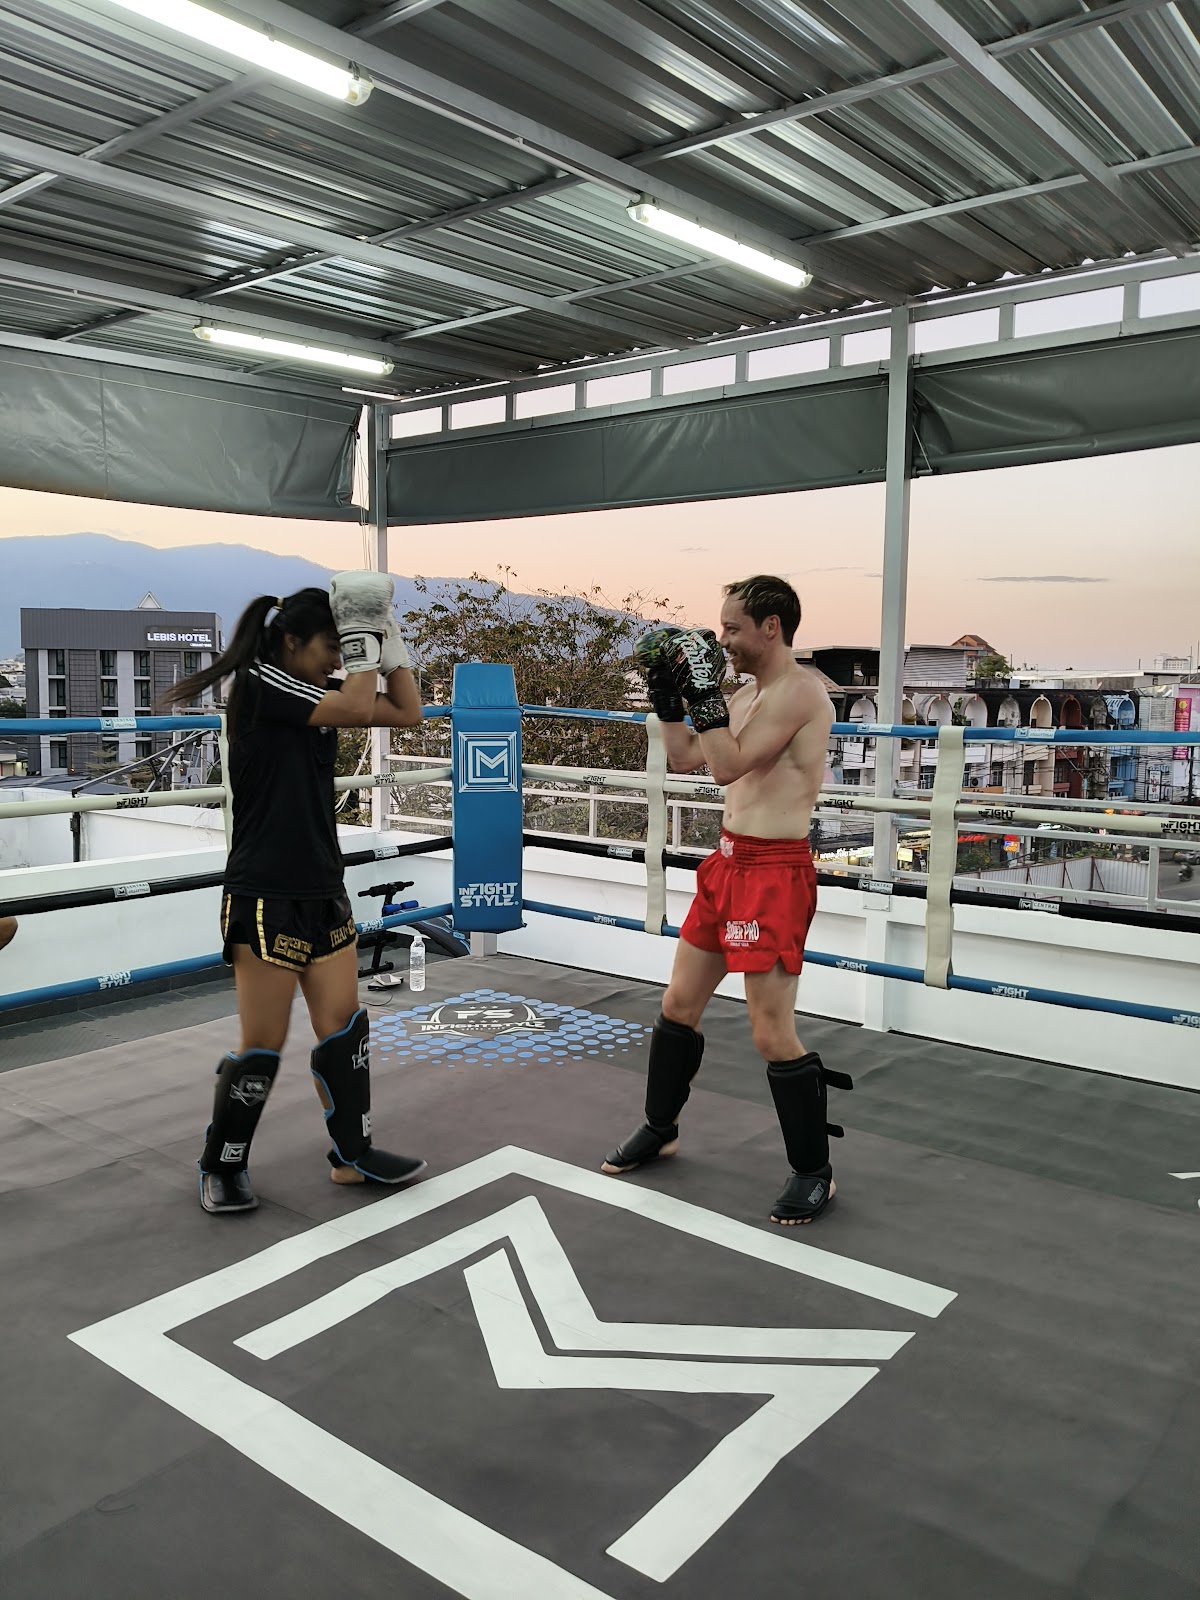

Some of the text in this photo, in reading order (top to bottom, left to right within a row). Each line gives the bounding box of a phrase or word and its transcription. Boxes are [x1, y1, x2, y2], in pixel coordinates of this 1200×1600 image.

[147, 632, 212, 643] LEBIS HOTEL
[725, 919, 760, 941] SUPER PRO
[991, 985, 1029, 998] INFIGHT
[453, 1009, 515, 1019] FS
[1172, 1013, 1200, 1025] INFIG
